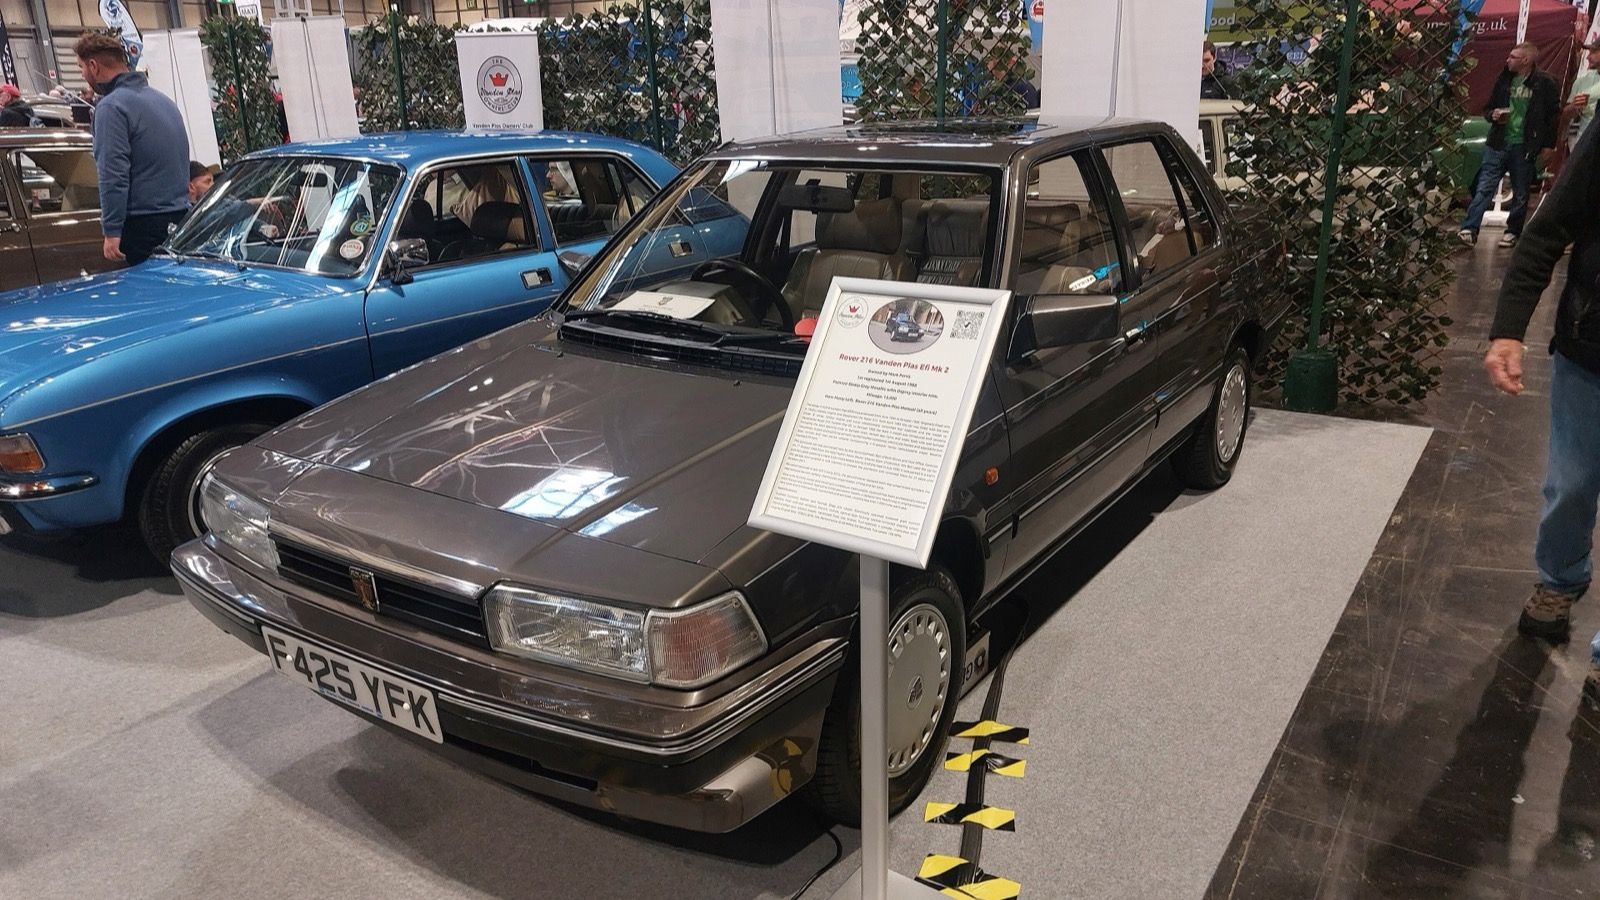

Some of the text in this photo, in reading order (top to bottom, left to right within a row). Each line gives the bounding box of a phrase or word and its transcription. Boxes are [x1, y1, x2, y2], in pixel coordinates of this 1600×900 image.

[839, 354, 859, 362] Rover
[875, 358, 902, 367] Vanden
[268, 634, 357, 702] F425
[360, 671, 436, 736] YFK
